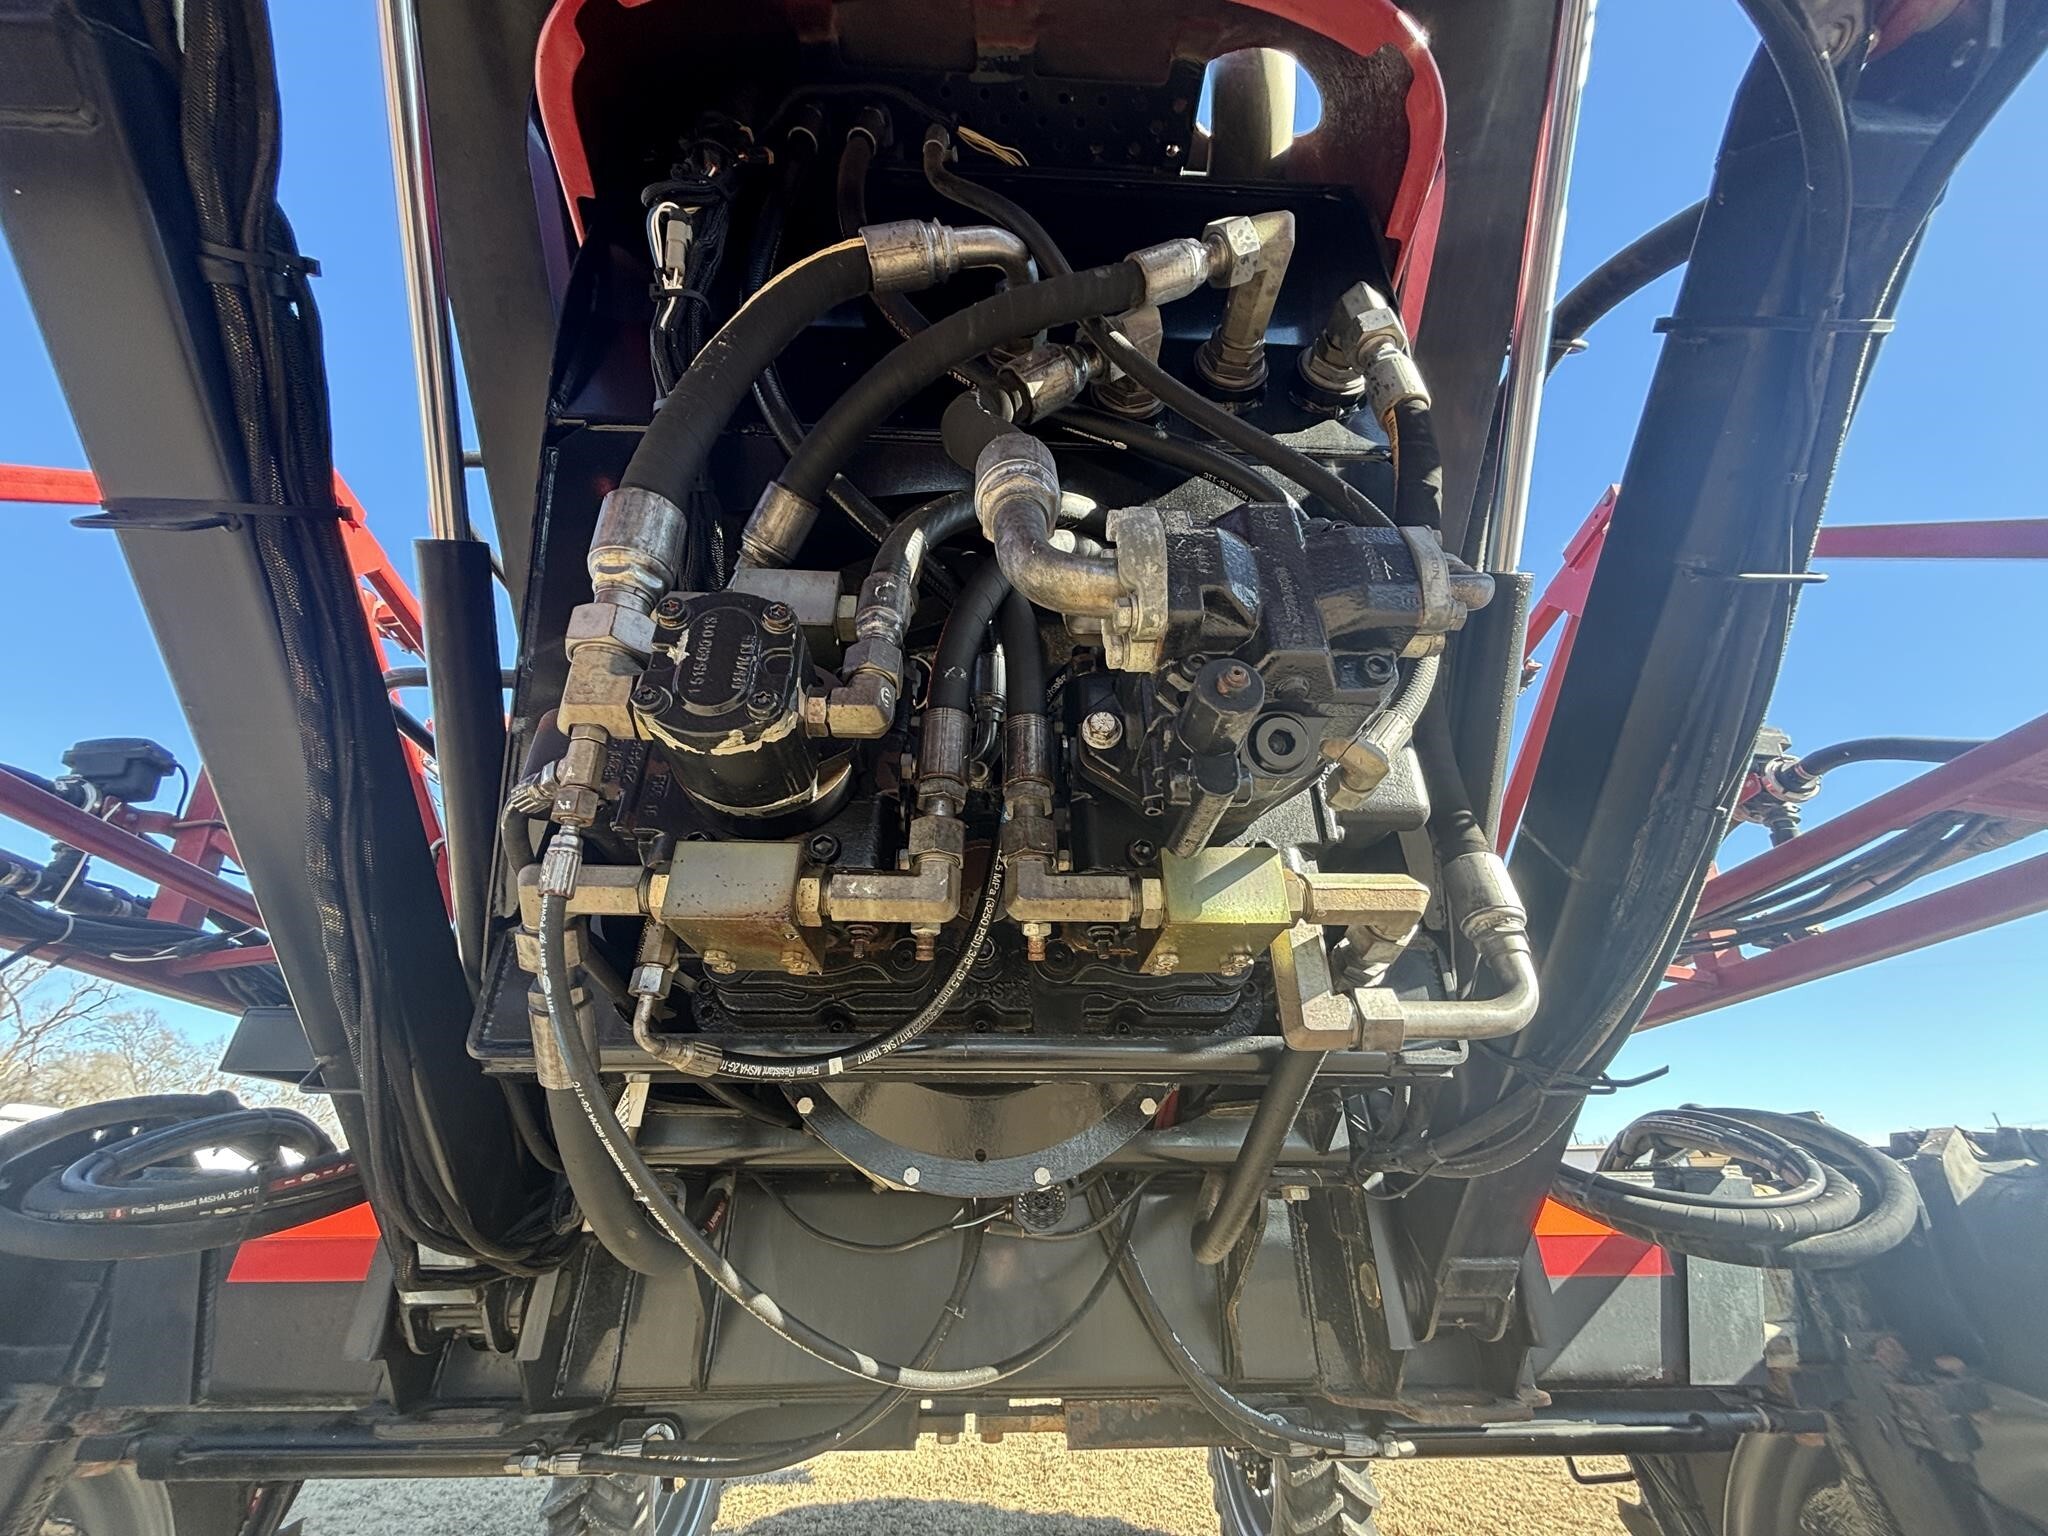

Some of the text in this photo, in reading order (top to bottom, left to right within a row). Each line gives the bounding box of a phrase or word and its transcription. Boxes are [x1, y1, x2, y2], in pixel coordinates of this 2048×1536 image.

[989, 873, 1003, 895] MPa
[980, 897, 996, 926] (3250
[970, 927, 987, 951] PSI)
[964, 949, 977, 970] 3/8"
[951, 968, 967, 989] (9.5
[938, 987, 954, 1008] mm)
[858, 1047, 882, 1065] 100R17
[881, 1040, 897, 1054] SAE
[739, 1063, 763, 1076] MSHA
[762, 1066, 796, 1077] Resistant
[796, 1065, 819, 1076] Flame
[198, 1193, 227, 1205] MSHA
[227, 1186, 260, 1199] 2G-11C
